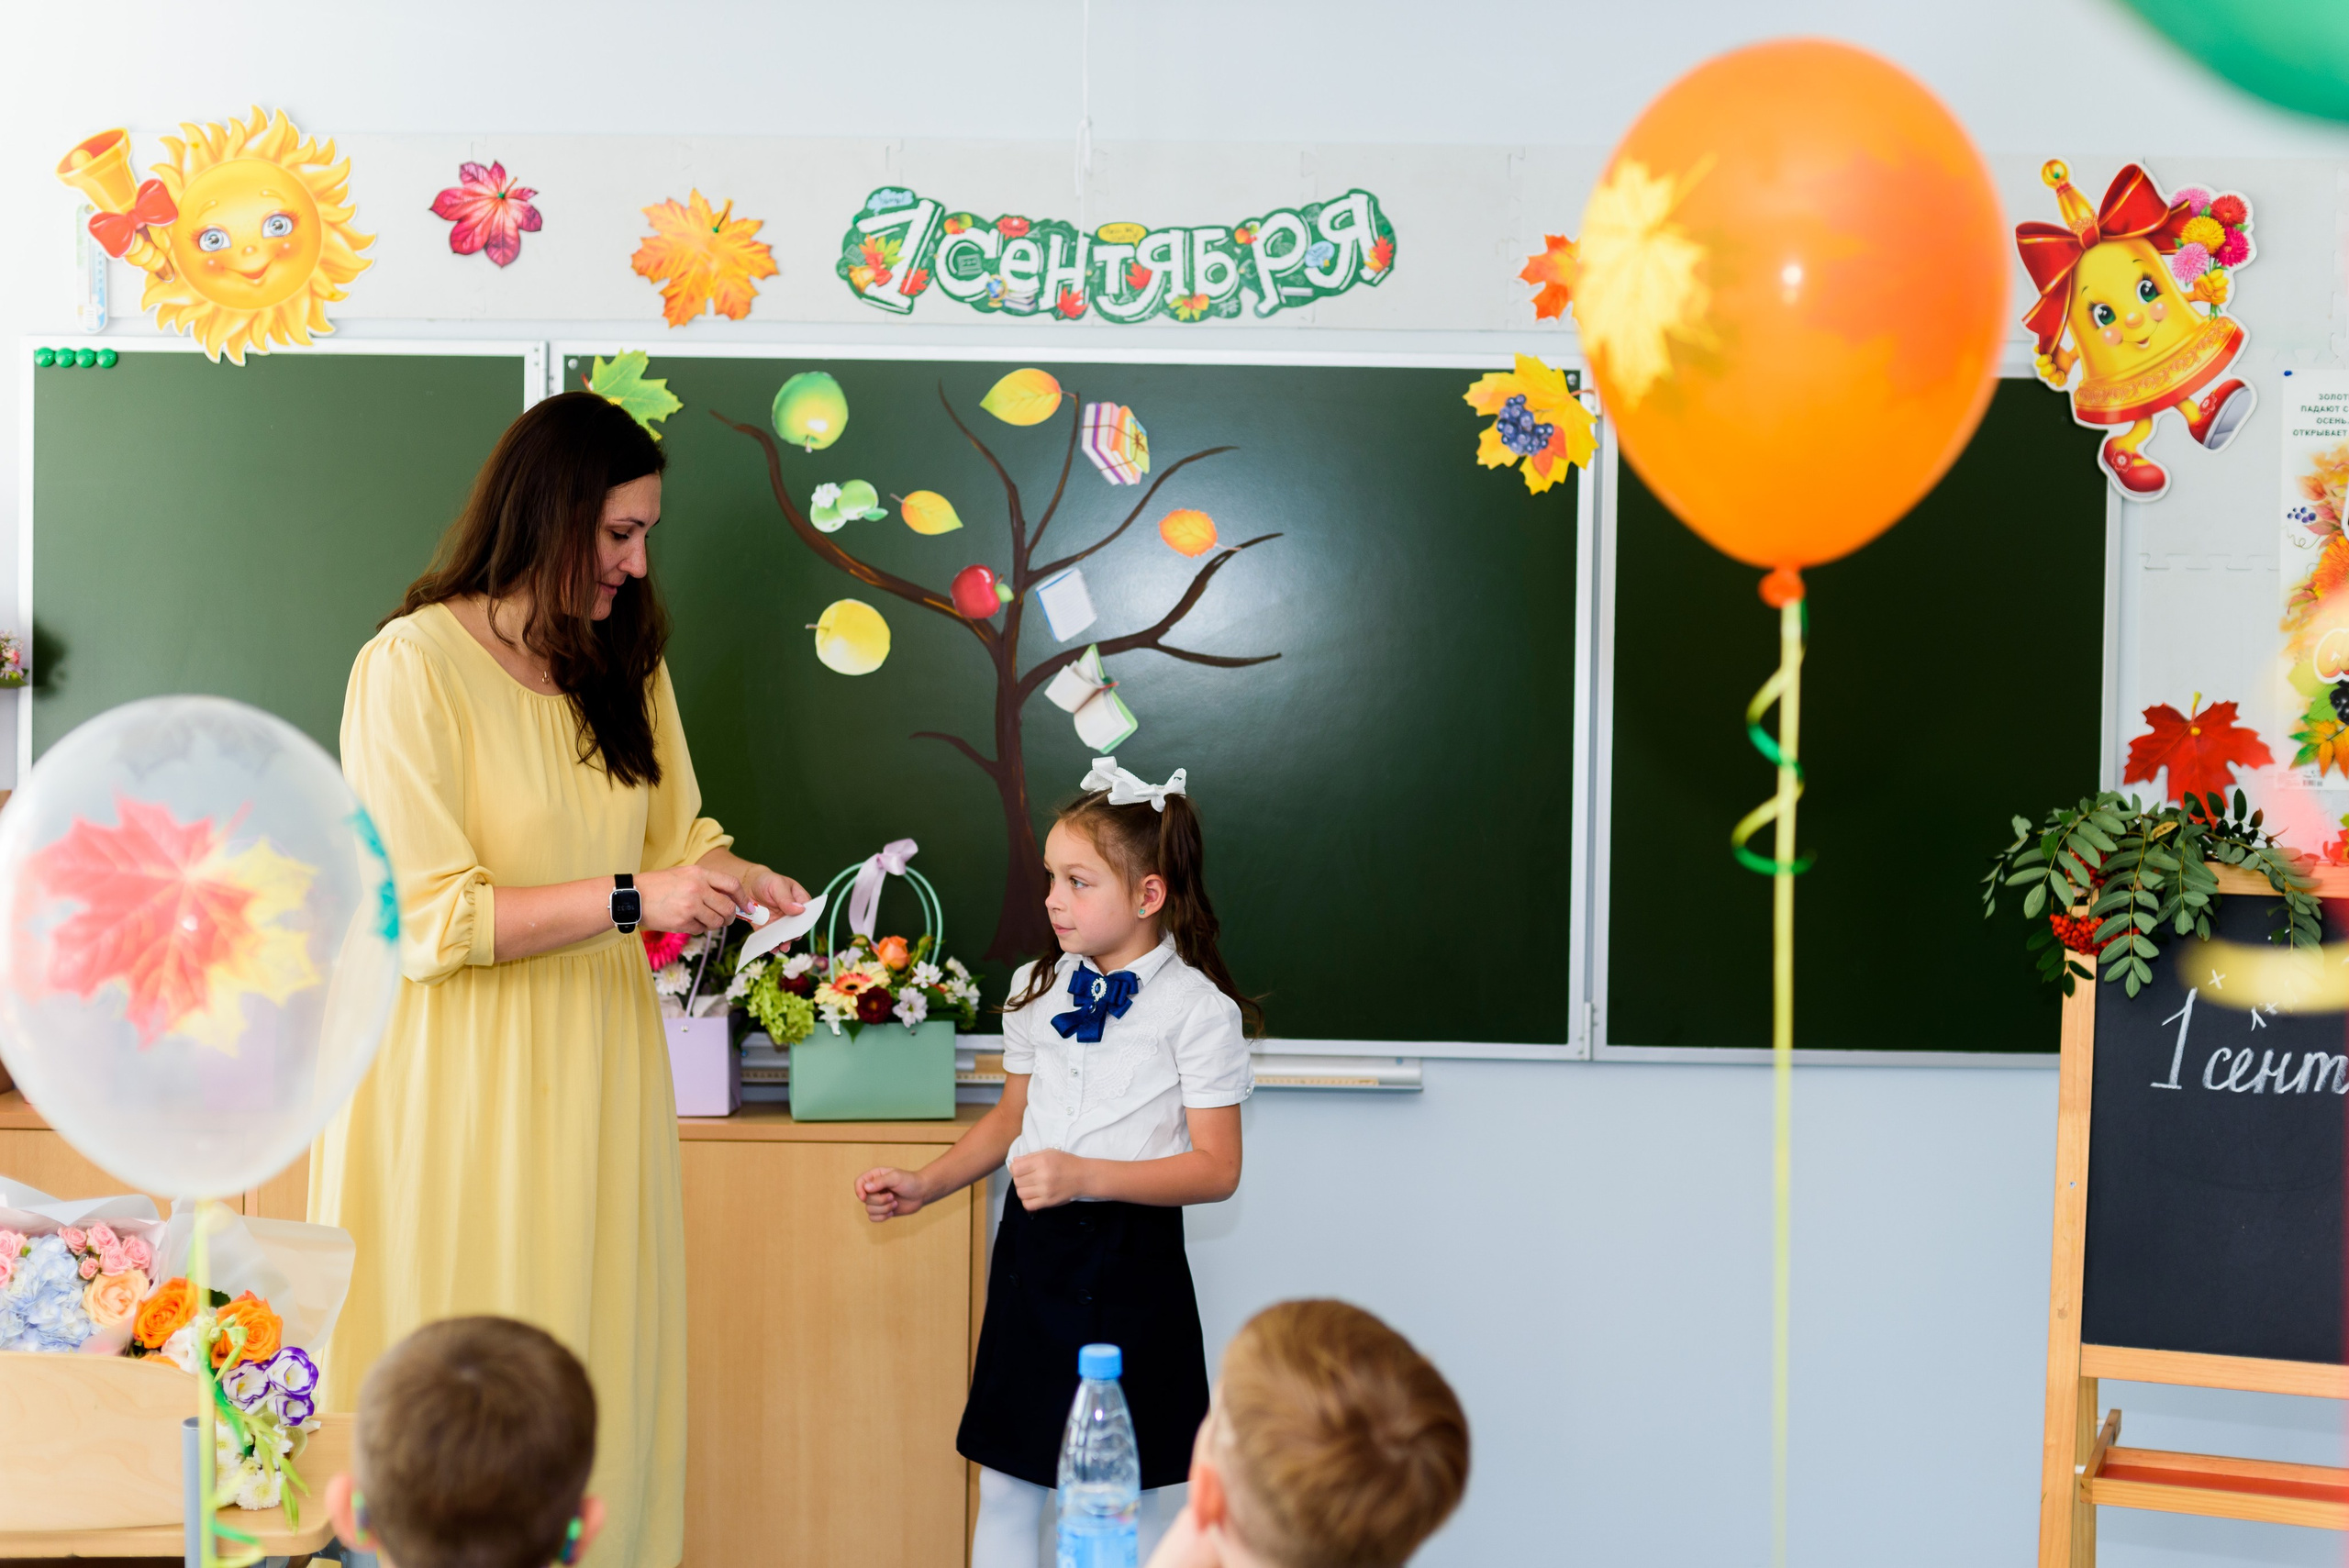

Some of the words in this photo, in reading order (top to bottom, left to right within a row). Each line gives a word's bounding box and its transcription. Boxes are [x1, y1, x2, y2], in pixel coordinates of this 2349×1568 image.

[855, 198, 936, 310] 1
[2292, 428, 2348, 437] ОТКРЫВАЕТ
[2300, 405, 2340, 413] ПАДАЮТ
[2150, 986, 2199, 1090] 1
